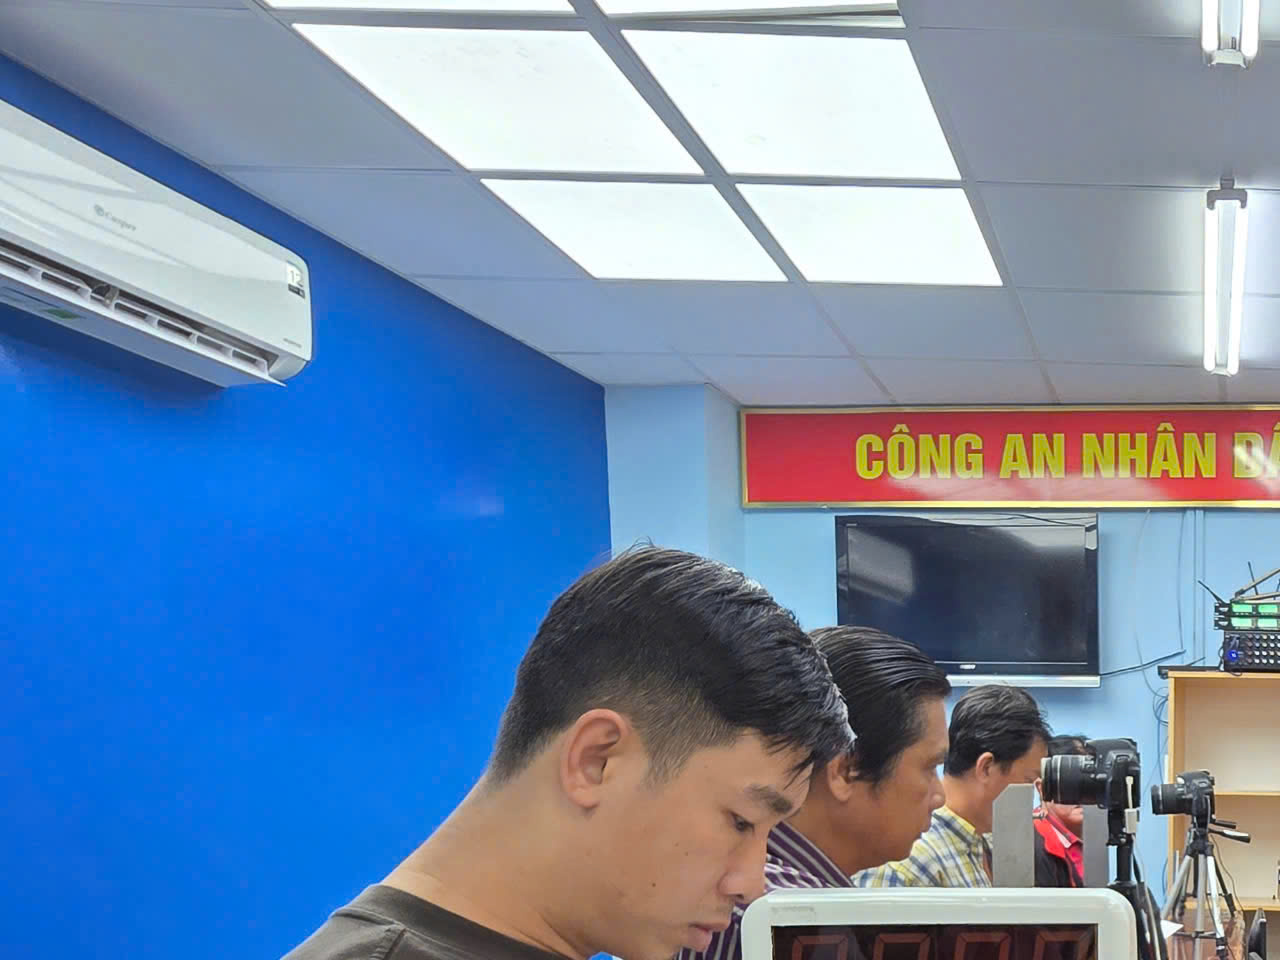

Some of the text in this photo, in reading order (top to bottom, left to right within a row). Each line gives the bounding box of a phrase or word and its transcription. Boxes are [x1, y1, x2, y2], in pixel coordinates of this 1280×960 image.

[856, 423, 983, 479] CÔNG
[1000, 432, 1069, 478] AN
[1082, 423, 1216, 478] NHÂN
